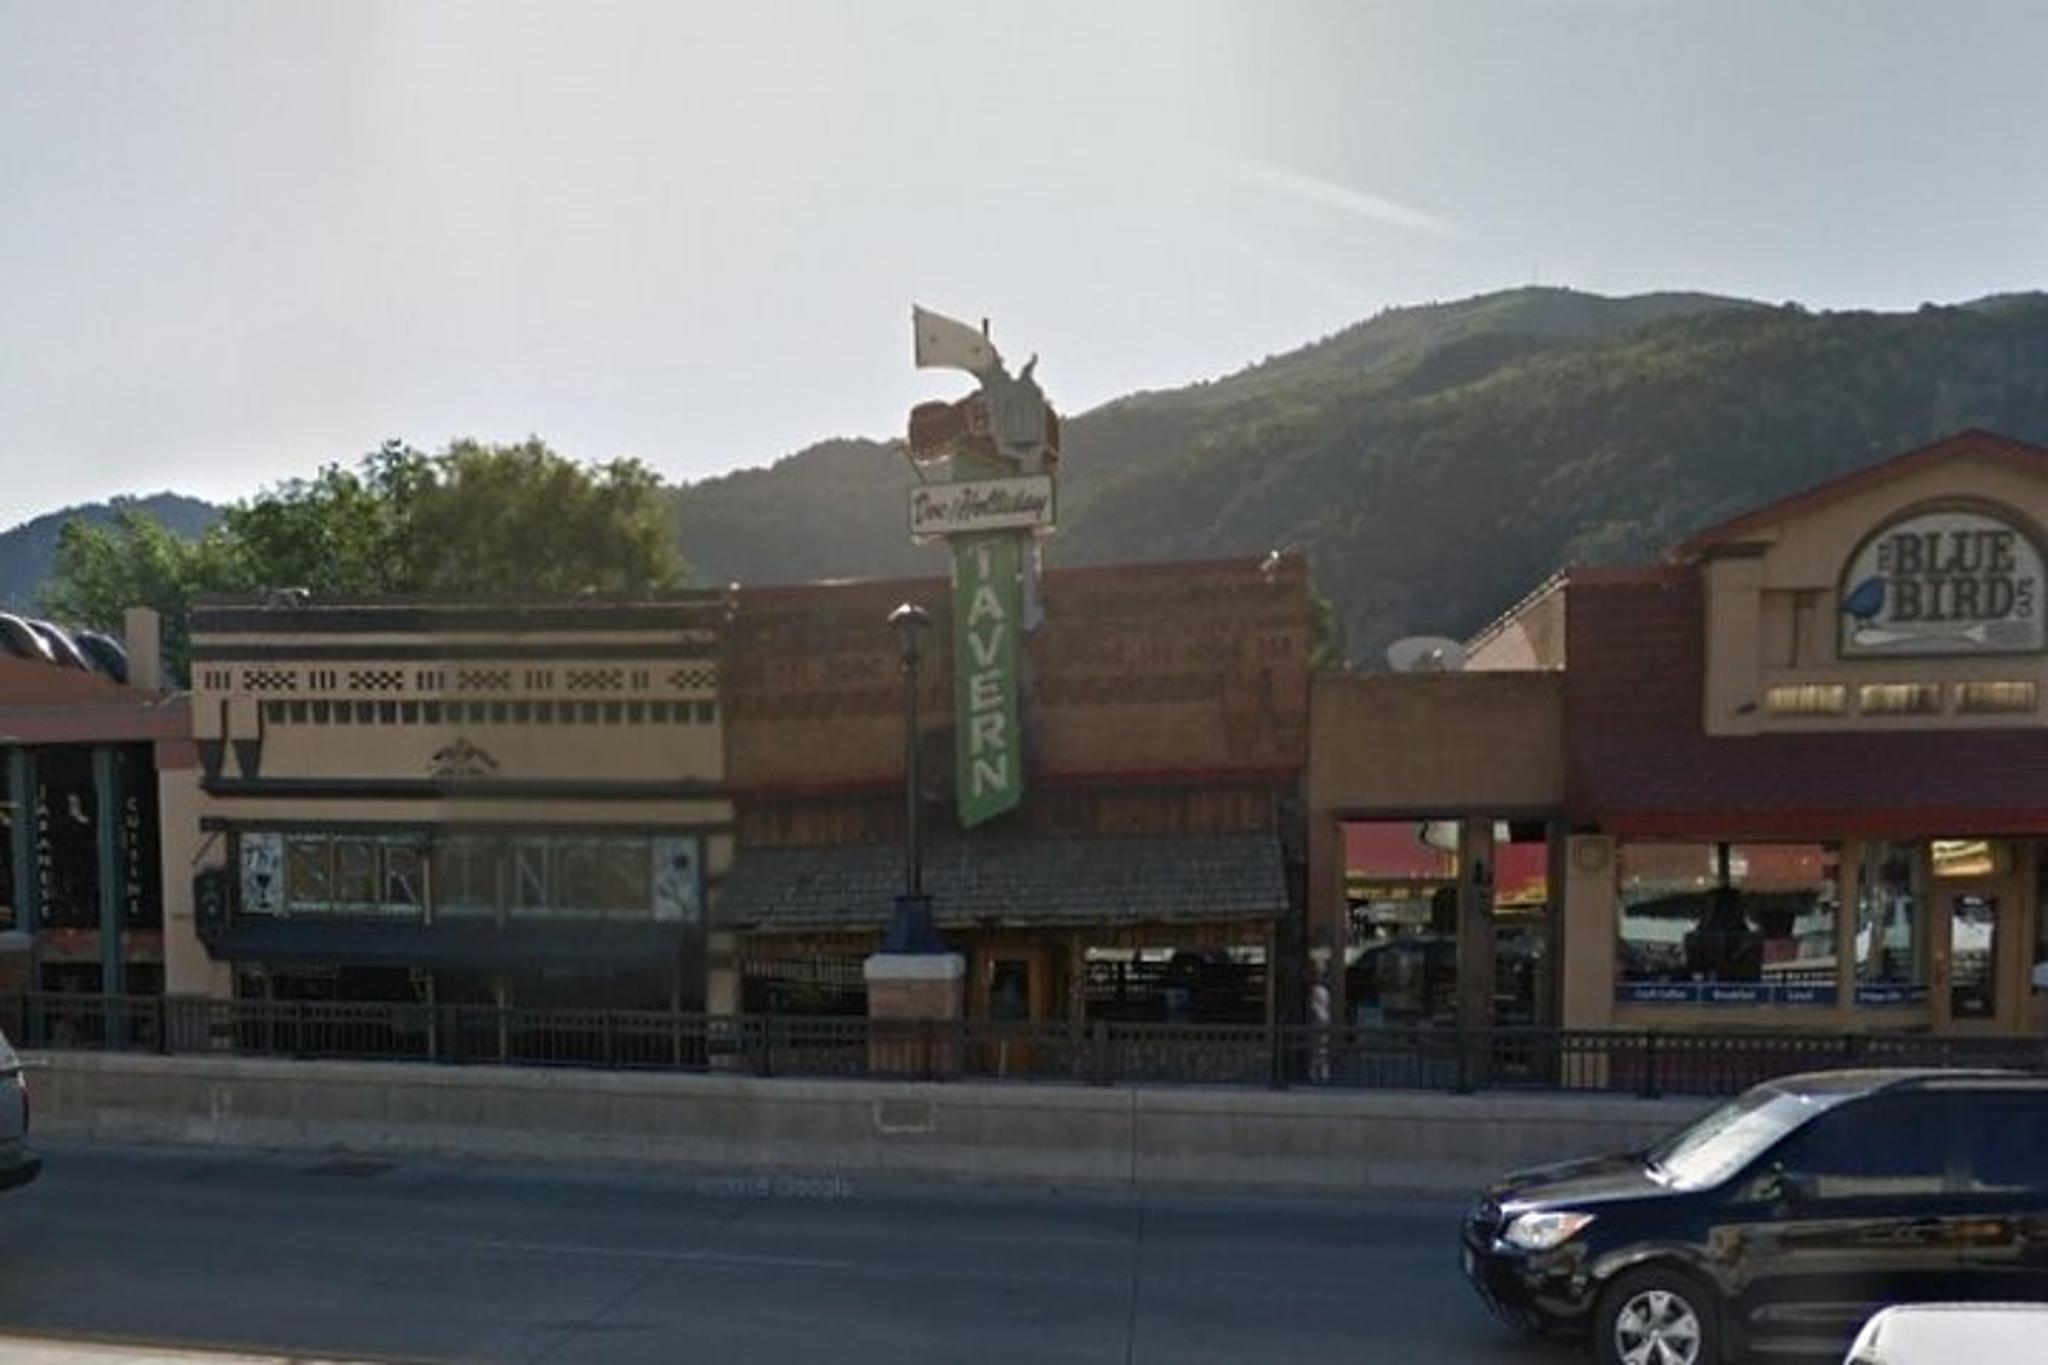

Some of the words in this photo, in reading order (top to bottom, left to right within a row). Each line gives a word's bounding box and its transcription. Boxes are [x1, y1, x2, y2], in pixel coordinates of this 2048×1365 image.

[1890, 531, 2015, 575] BLUE
[1888, 576, 2015, 621] BIRD
[967, 542, 1007, 797] TAVERN
